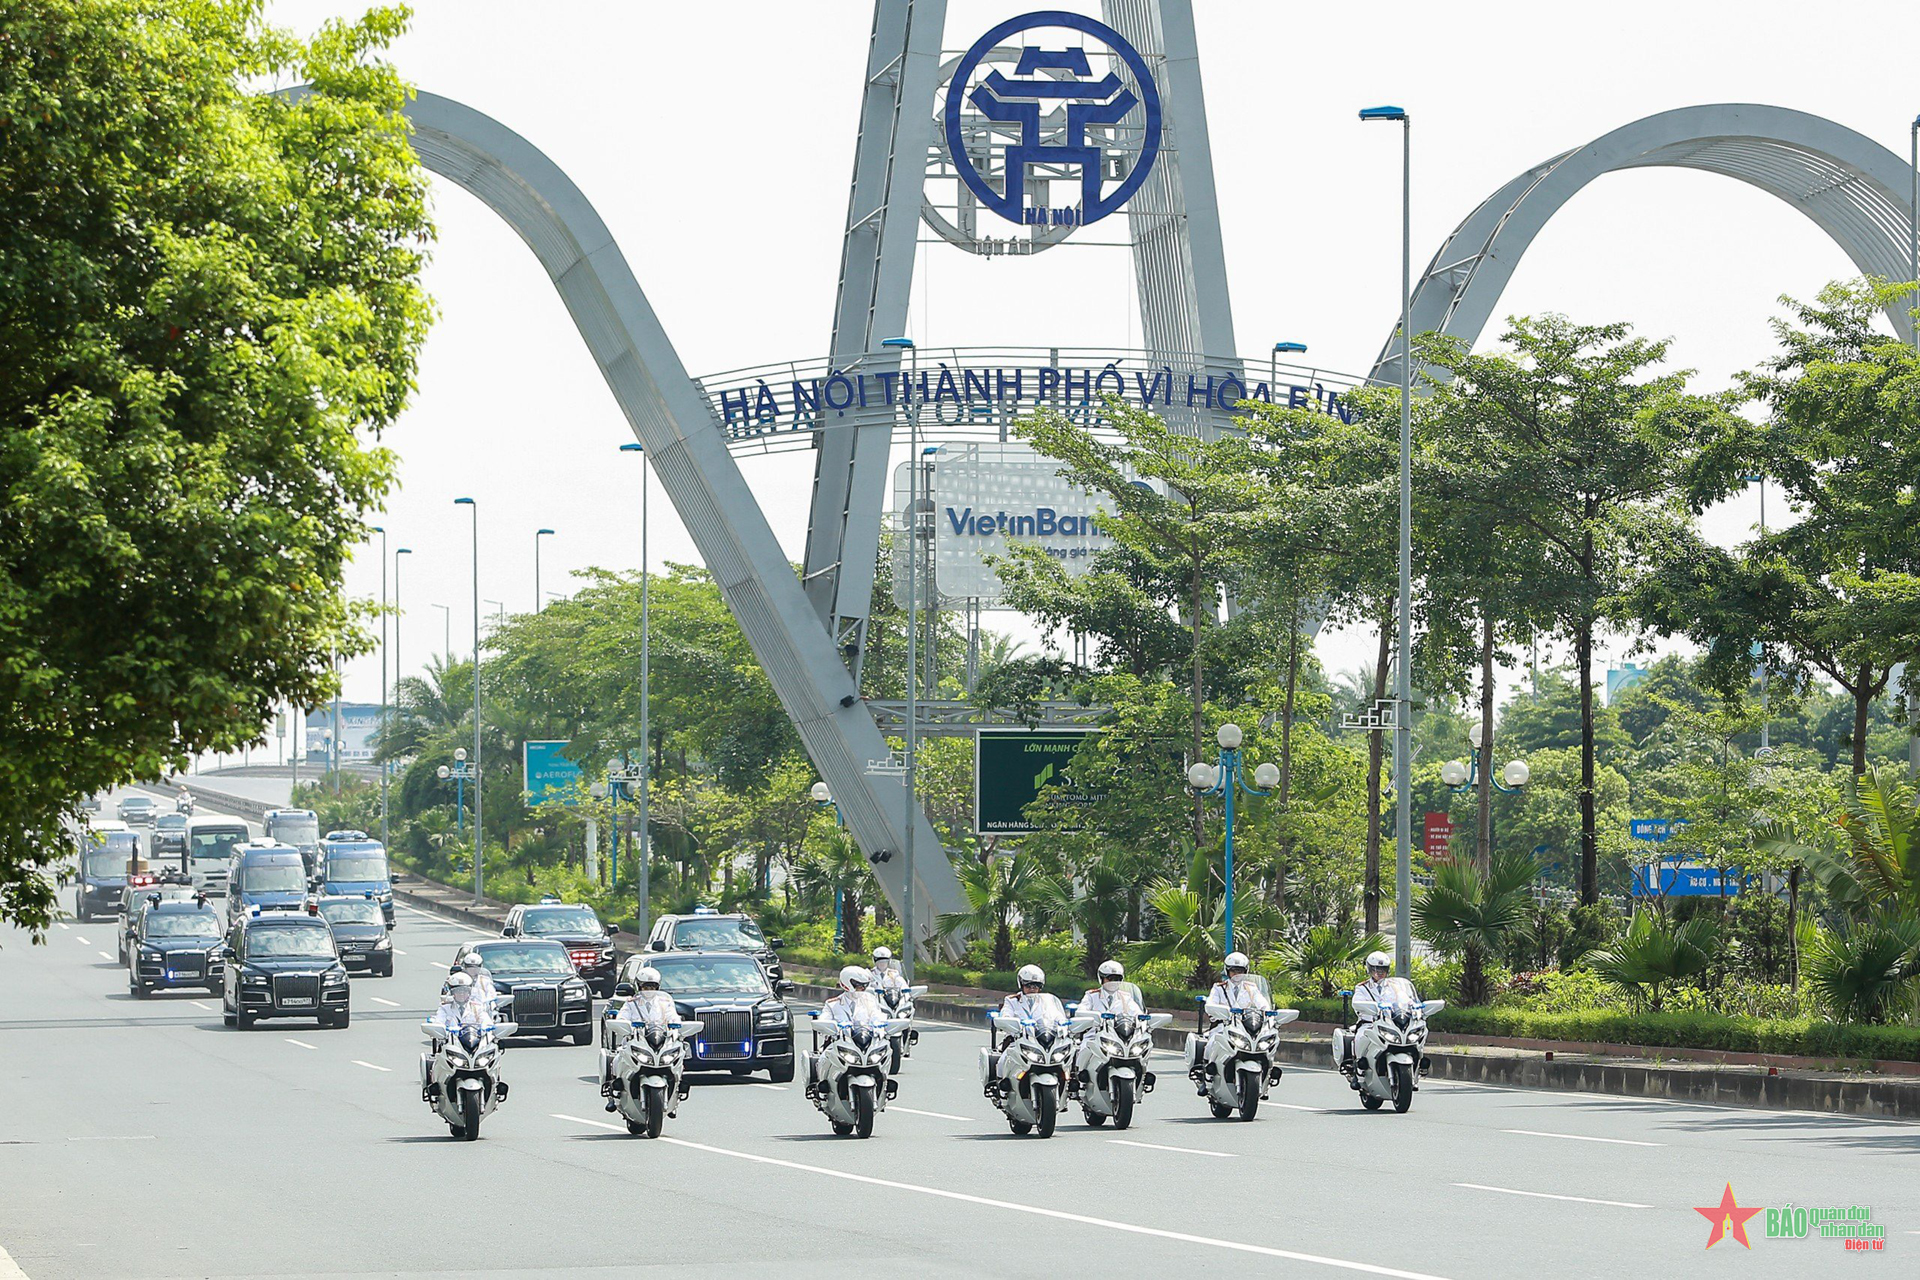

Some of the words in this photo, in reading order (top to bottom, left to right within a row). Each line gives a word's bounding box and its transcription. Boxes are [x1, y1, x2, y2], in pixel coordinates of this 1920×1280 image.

[1052, 205, 1081, 230] NỘI
[720, 379, 782, 424] HÀ
[791, 369, 868, 417] NỘI
[874, 363, 1022, 405] THÀNH
[1039, 359, 1126, 402] PHỐ
[1135, 367, 1173, 406] VÌ
[946, 508, 1118, 536] VietinBan
[1024, 742, 1042, 752] LỚN
[1043, 744, 1071, 754] MẠNH
